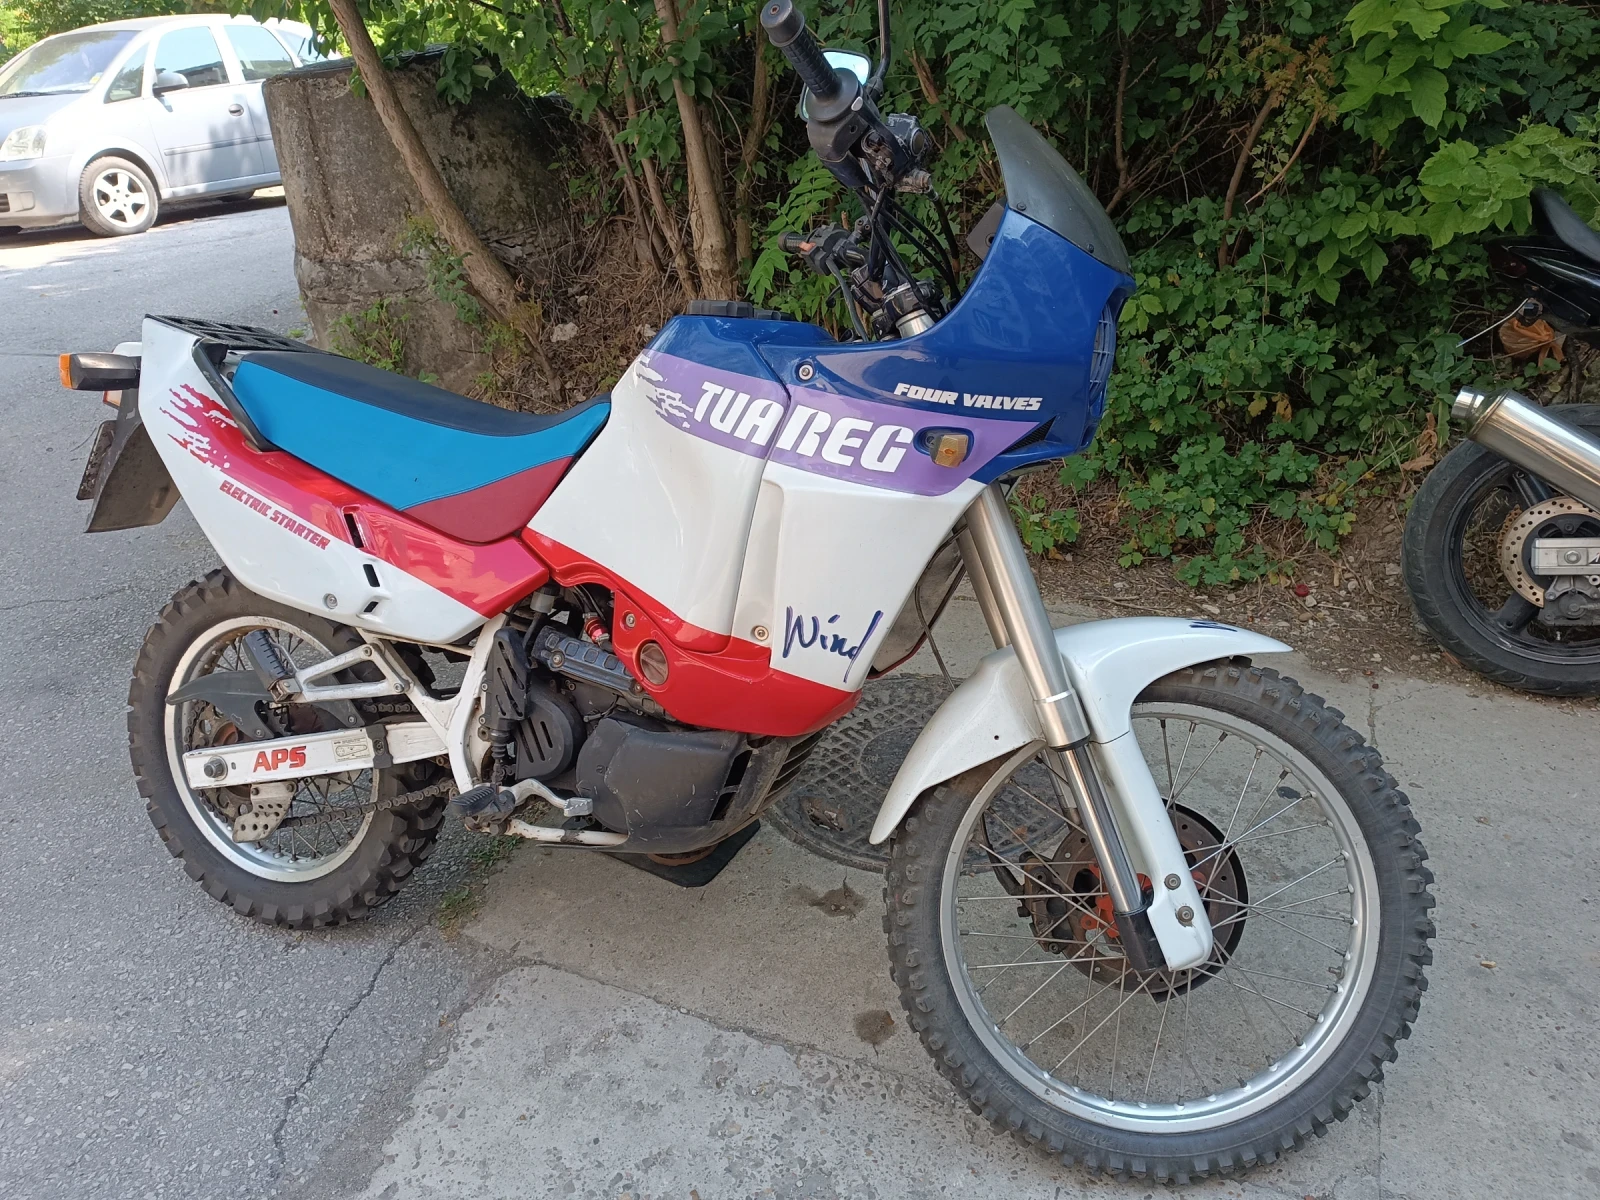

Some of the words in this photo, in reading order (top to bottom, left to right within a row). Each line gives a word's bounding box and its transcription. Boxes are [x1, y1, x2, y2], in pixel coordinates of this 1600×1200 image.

[694, 381, 914, 473] TUAREG
[893, 382, 958, 406] FOUR
[963, 392, 1043, 412] VALVES
[219, 480, 272, 517] ELECTRIC
[269, 509, 331, 550] STARTER
[782, 606, 884, 683] Wind
[253, 746, 307, 773] APS
